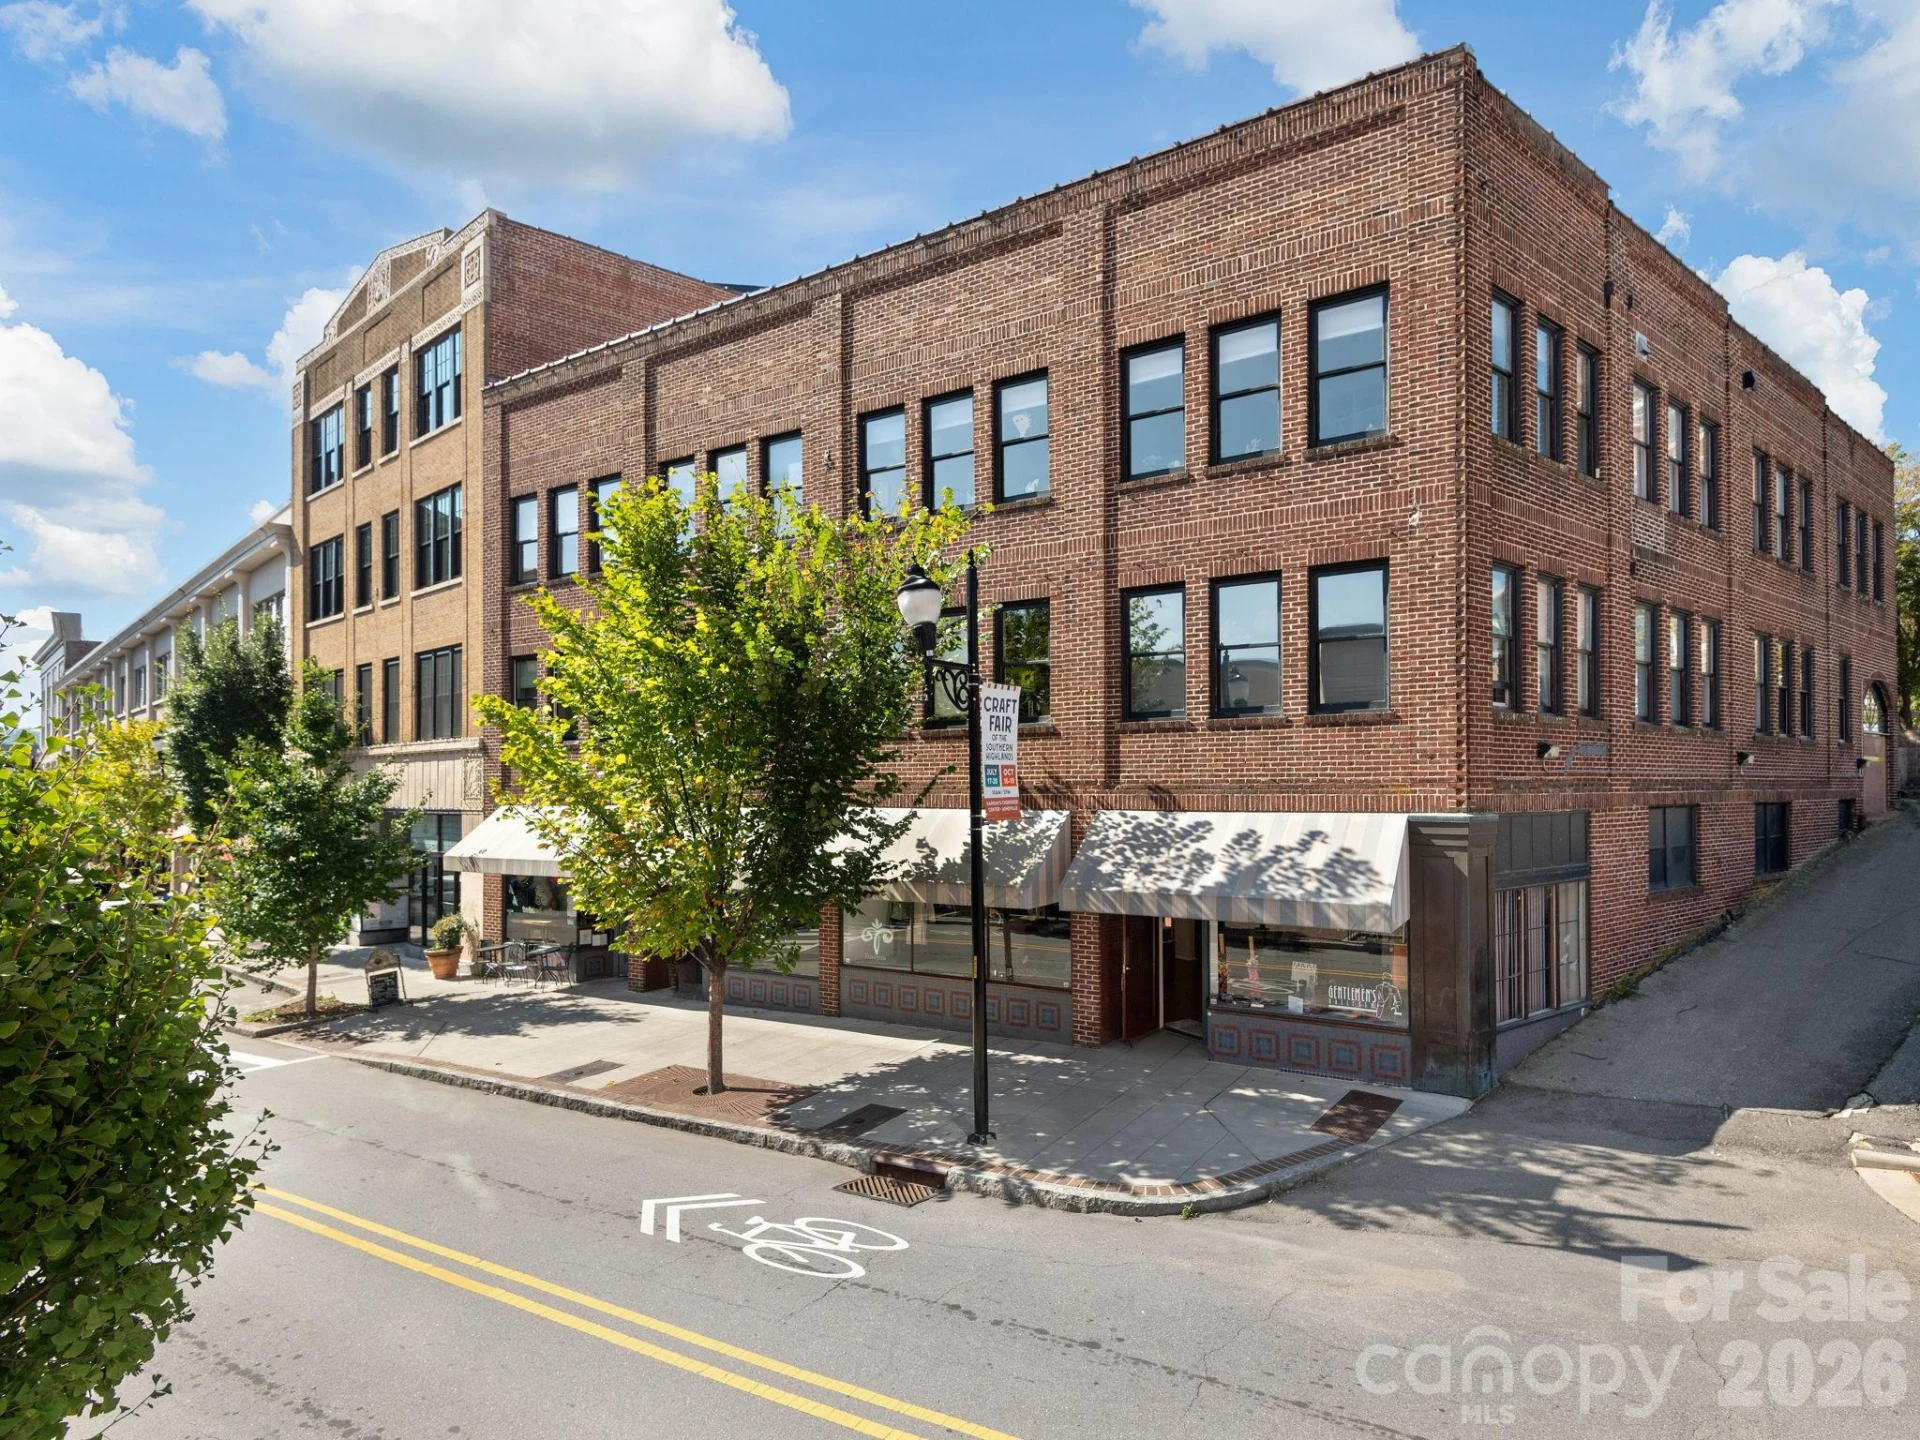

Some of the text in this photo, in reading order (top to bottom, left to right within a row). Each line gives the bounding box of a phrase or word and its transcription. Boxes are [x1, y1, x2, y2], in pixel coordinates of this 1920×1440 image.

[984, 696, 1017, 714] CRAFT
[989, 715, 1012, 733] FAIR
[985, 743, 1013, 751] SOUTHERN
[985, 752, 1013, 760] HIGHLANDS
[987, 768, 998, 776] JULY
[1328, 985, 1377, 1003] GENTLEMEN'S
